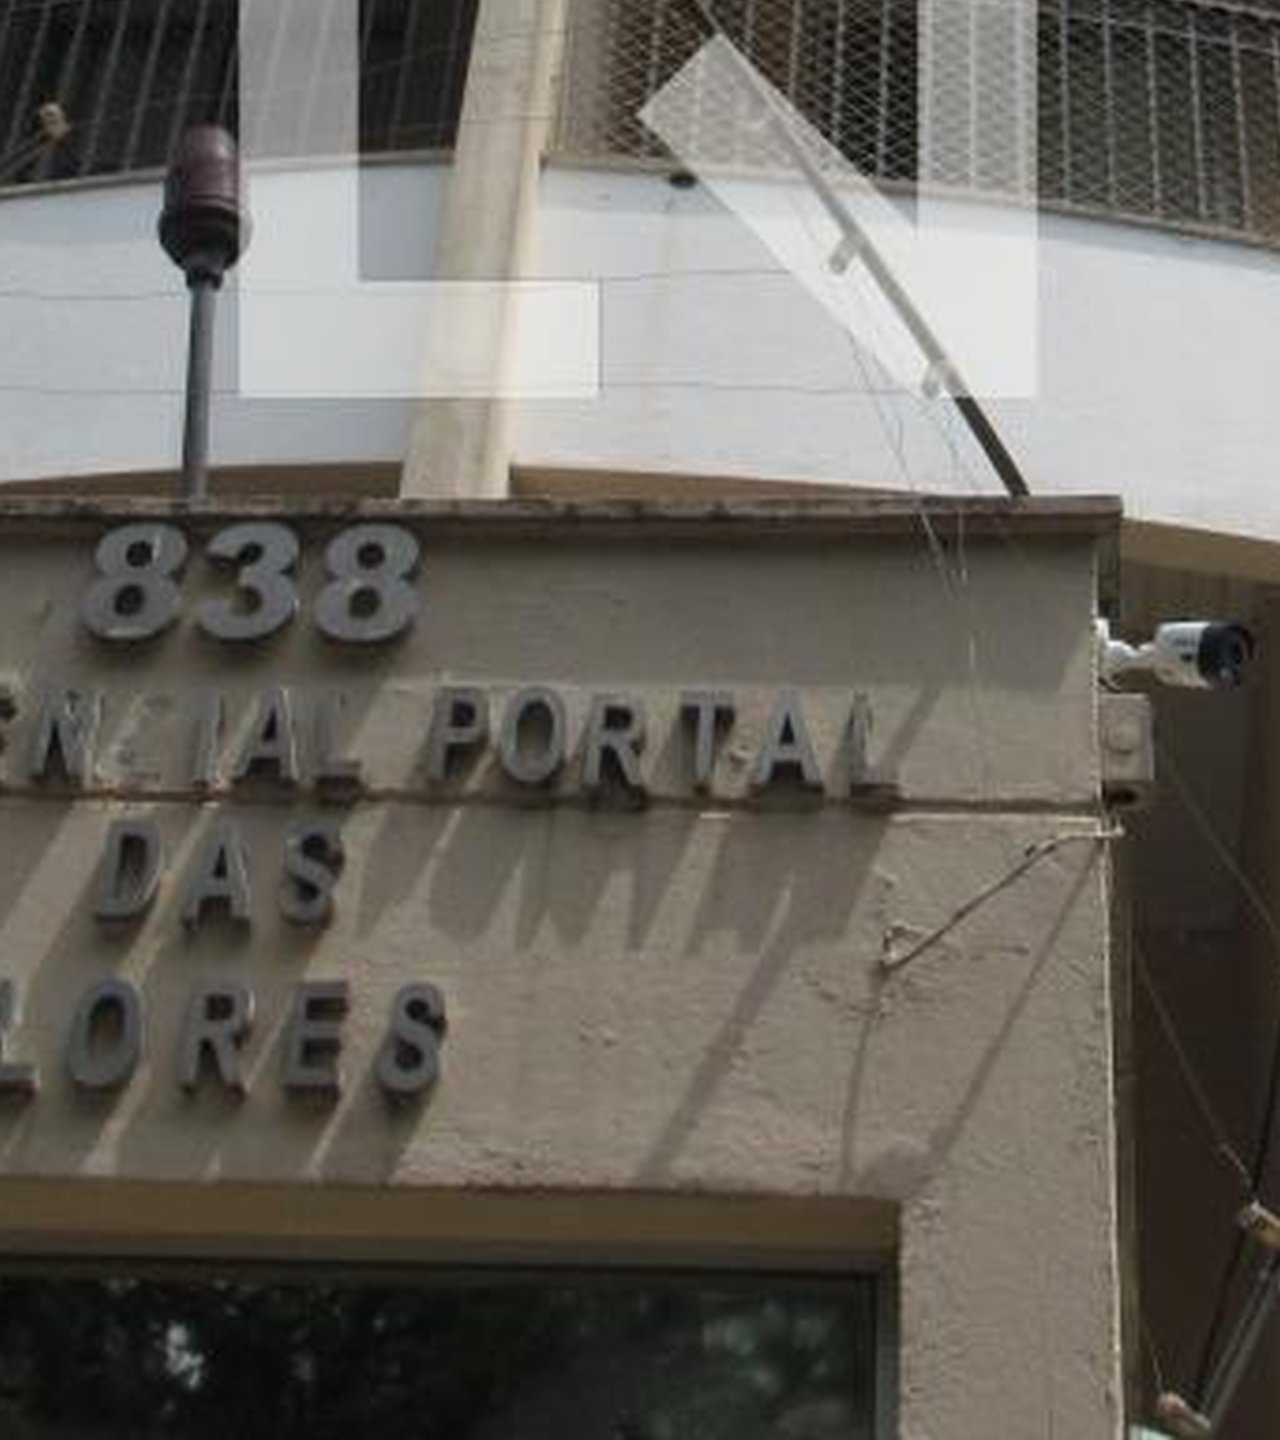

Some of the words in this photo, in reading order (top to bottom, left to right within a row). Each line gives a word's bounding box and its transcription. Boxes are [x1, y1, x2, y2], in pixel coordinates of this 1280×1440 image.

[84, 523, 420, 642] 838
[427, 686, 892, 792] PORTAL
[93, 816, 344, 928] DAS
